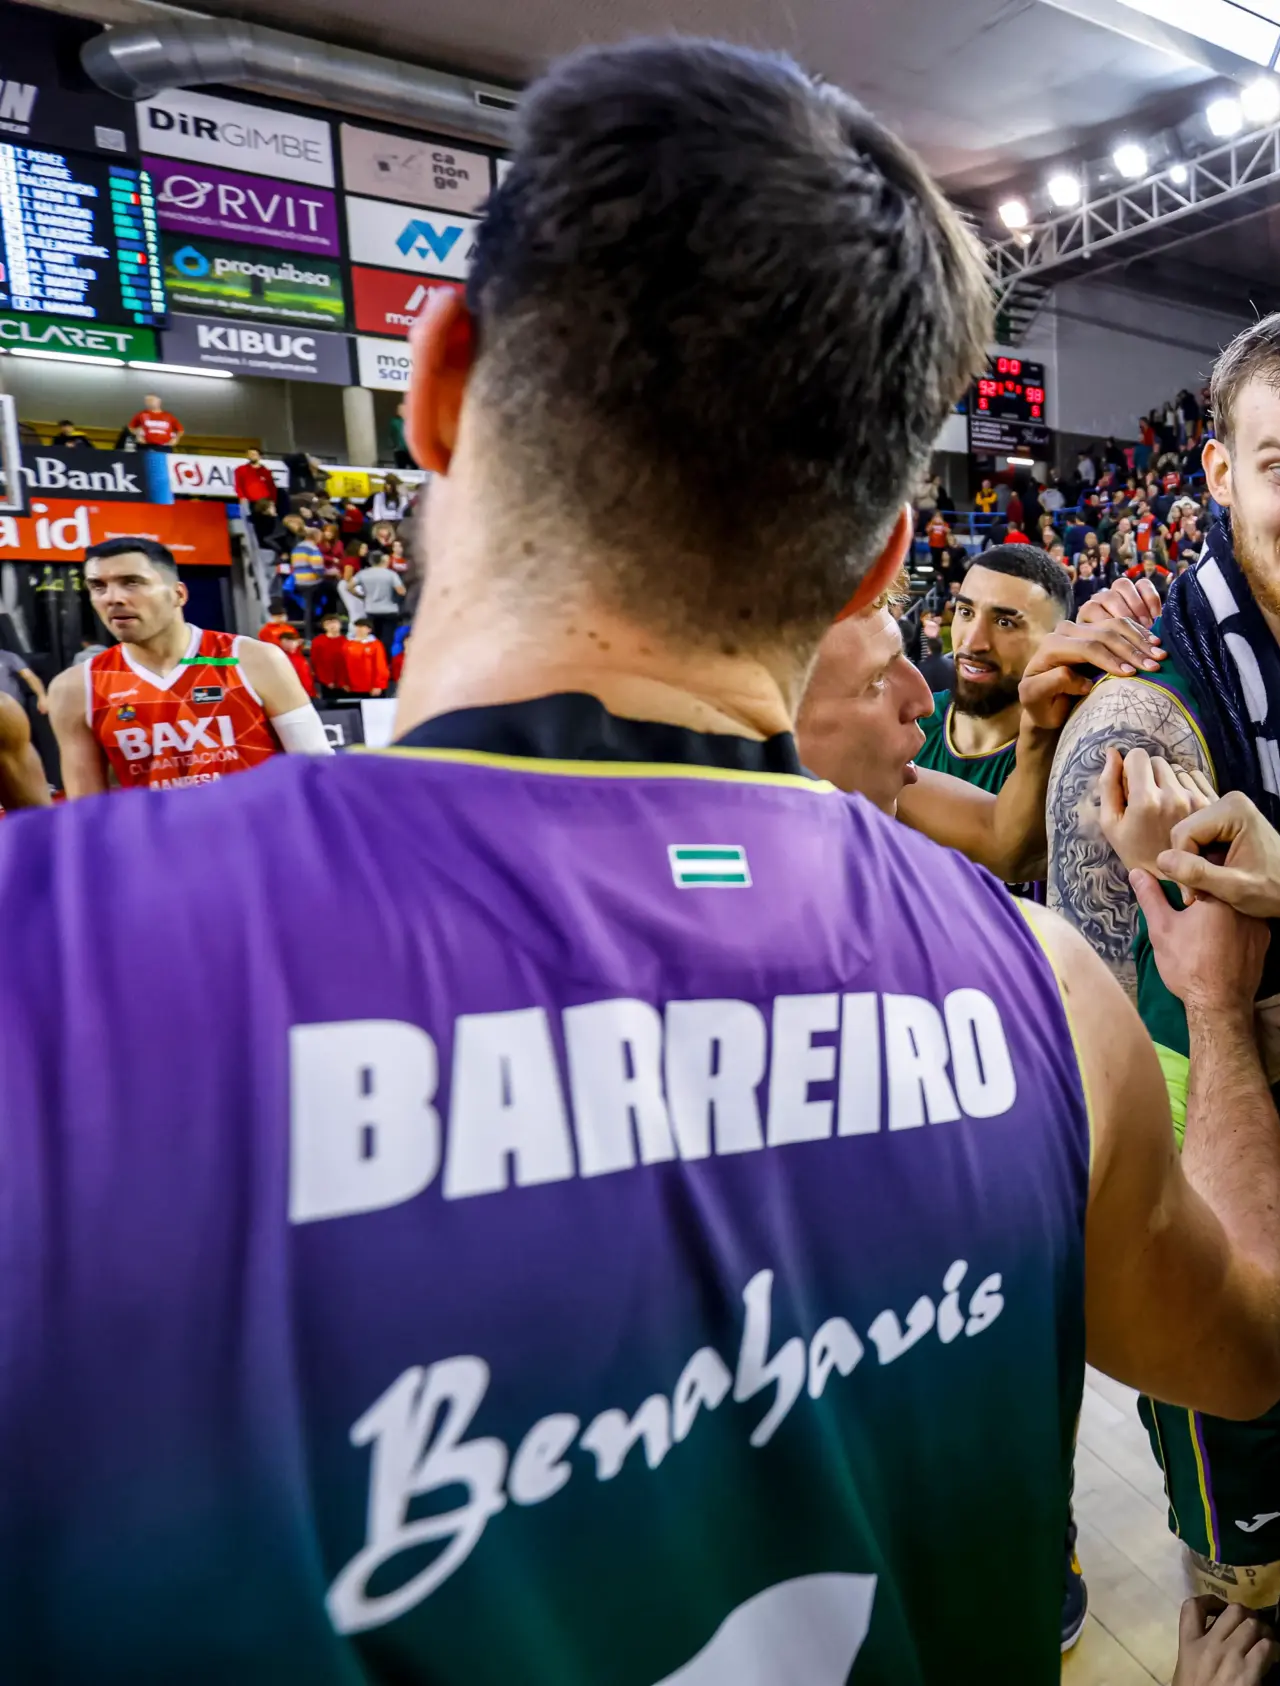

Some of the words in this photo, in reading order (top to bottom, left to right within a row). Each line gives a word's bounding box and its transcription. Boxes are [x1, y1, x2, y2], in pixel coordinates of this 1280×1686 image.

[148, 107, 323, 164] DiRGIMBE
[431, 152, 456, 166] ca
[431, 164, 470, 181] non
[434, 175, 459, 190] ge
[214, 257, 331, 288] proquibsa
[197, 324, 318, 361] KIBUC
[113, 715, 237, 761] BAXI
[288, 987, 1018, 1224] BARREIRO
